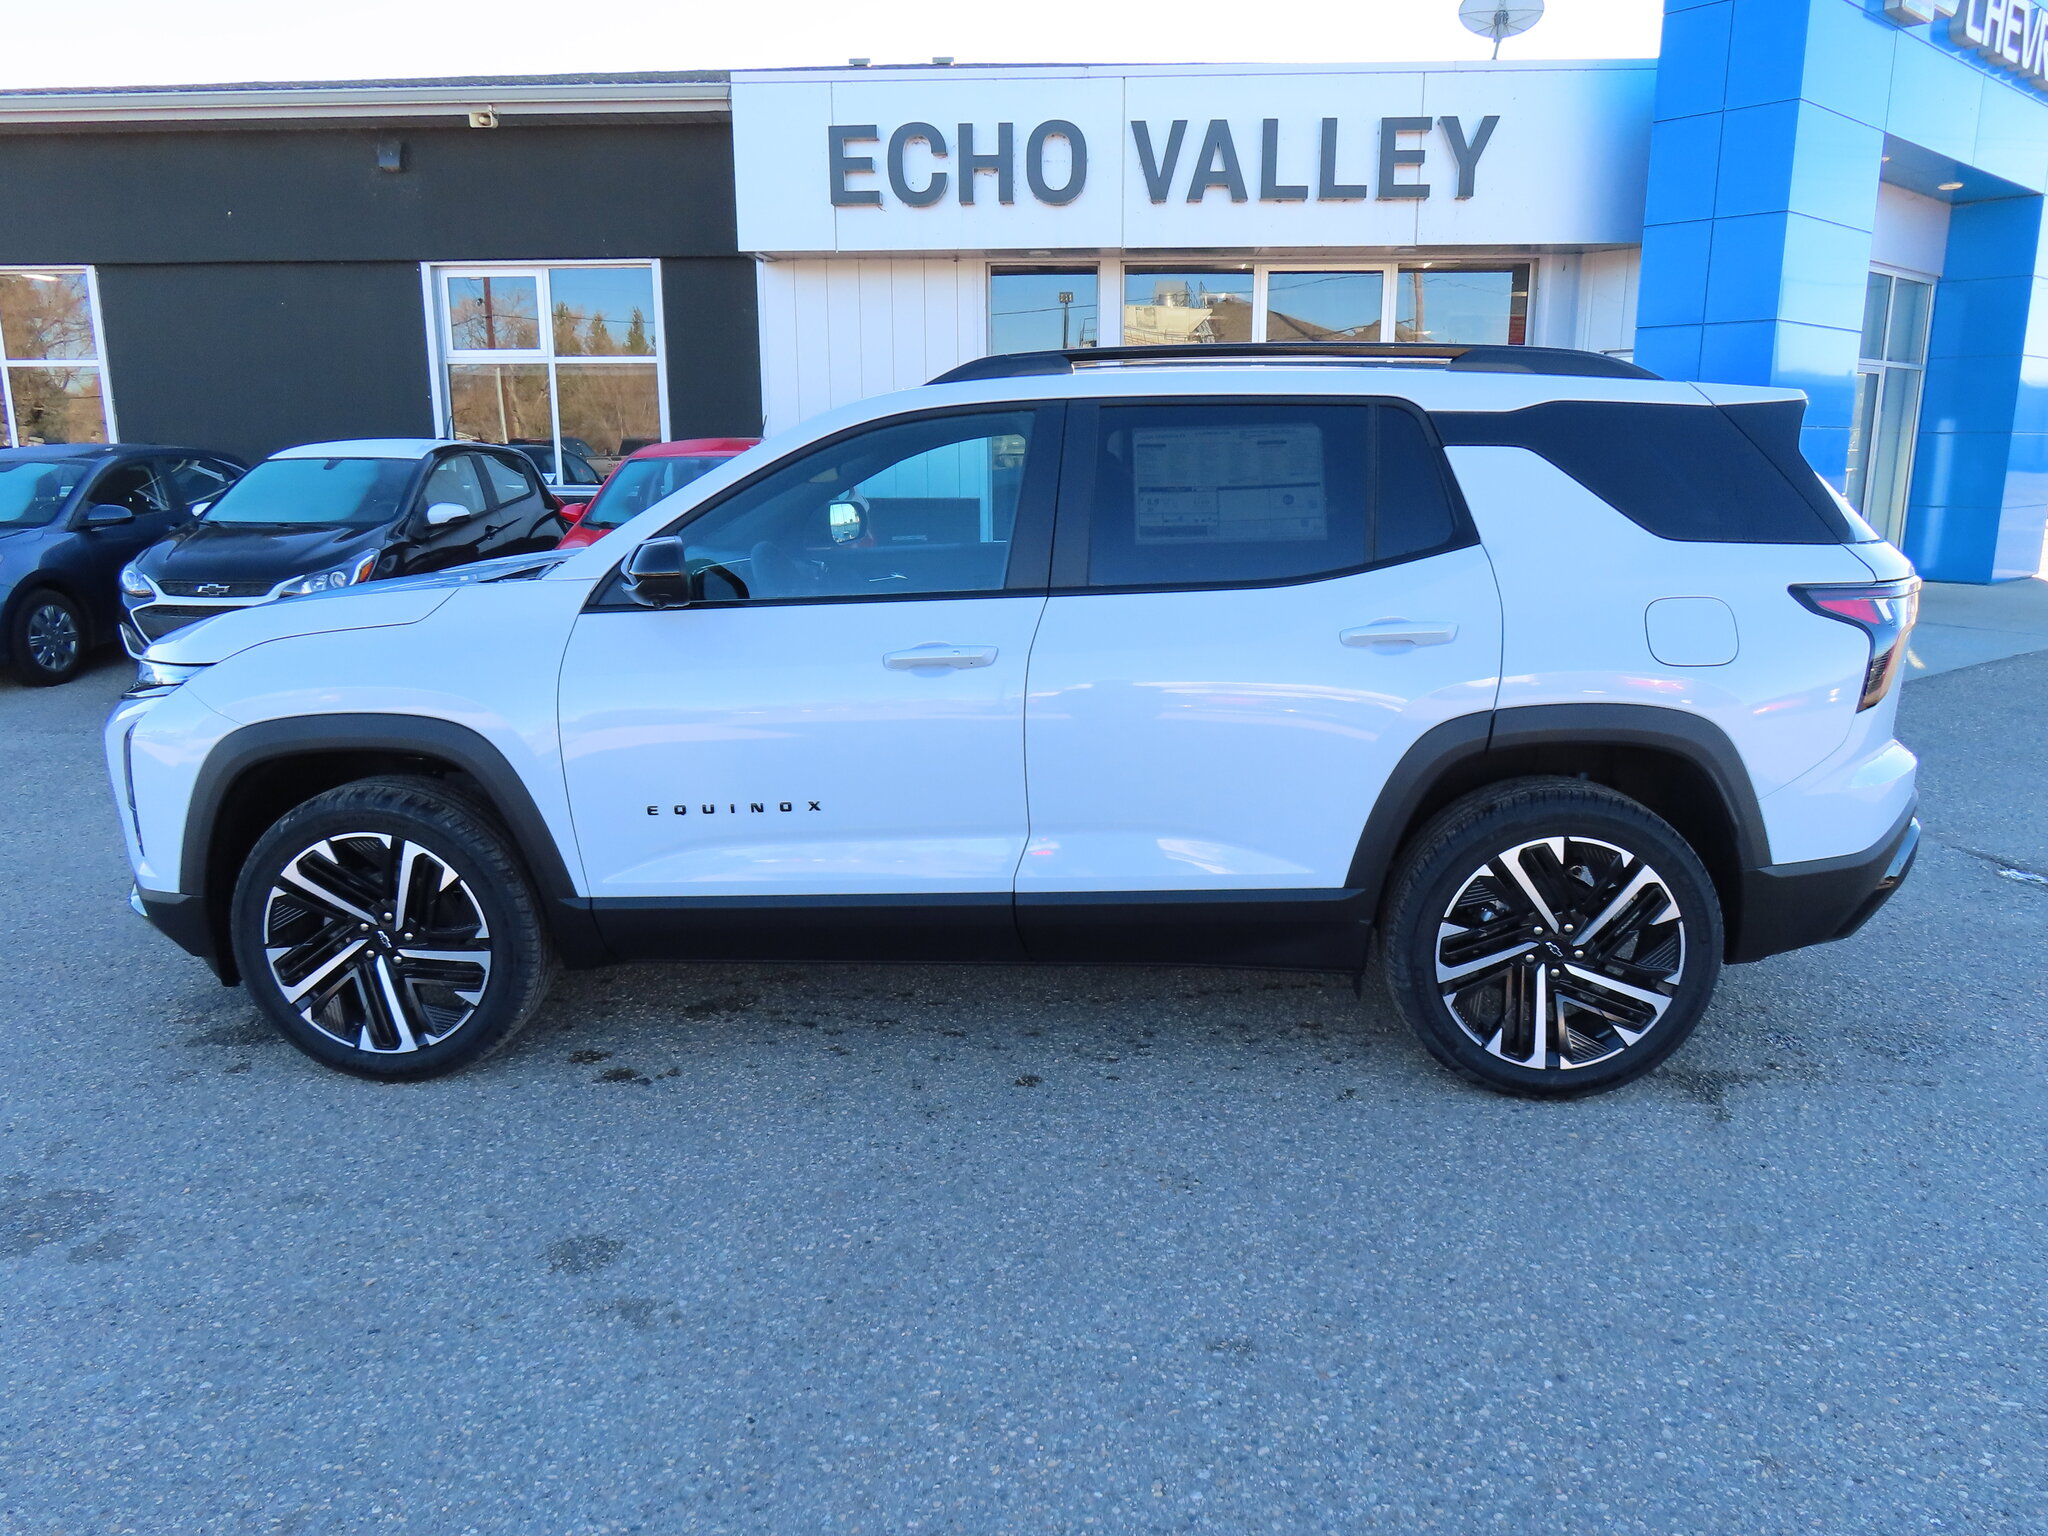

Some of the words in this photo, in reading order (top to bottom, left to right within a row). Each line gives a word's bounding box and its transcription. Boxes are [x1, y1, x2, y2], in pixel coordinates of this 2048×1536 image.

[828, 119, 1088, 207] ECHO
[1130, 115, 1501, 204] VALLEY
[646, 801, 822, 815] EQUINOX
